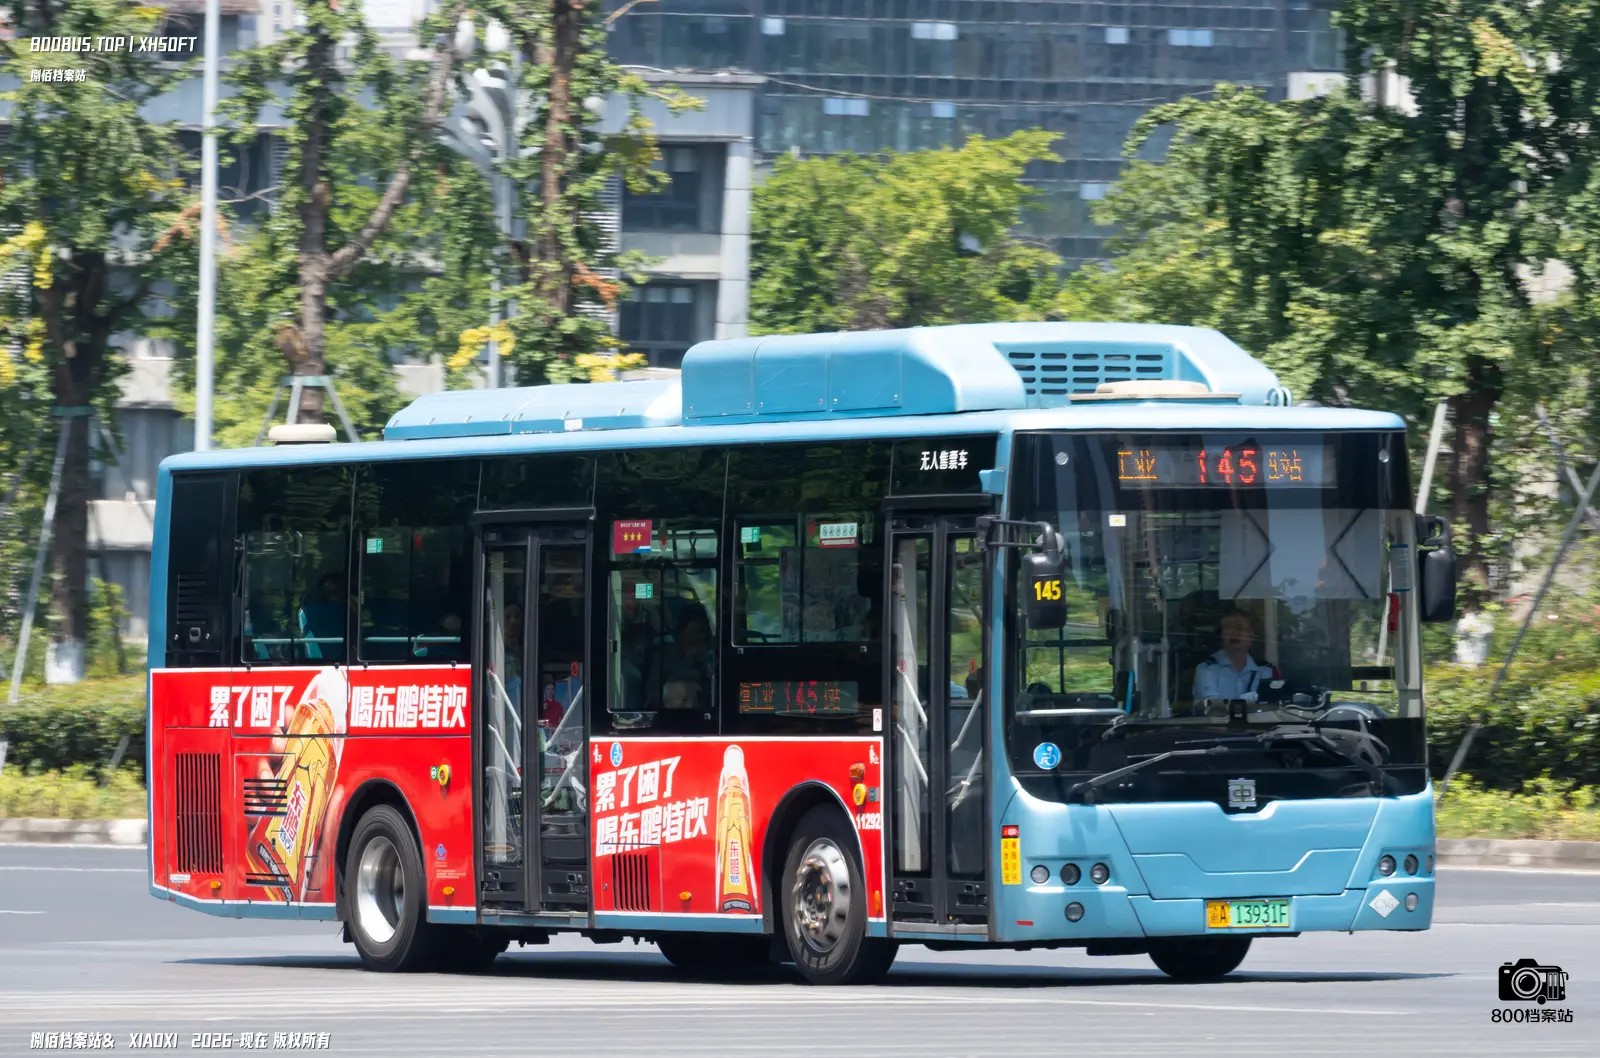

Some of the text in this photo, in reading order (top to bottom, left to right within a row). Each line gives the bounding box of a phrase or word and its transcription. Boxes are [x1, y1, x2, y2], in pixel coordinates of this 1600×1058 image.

[920, 449, 968, 470] 无人售票车
[1197, 449, 1257, 484] 145
[1034, 580, 1062, 600] 145
[209, 683, 467, 729] 累了困了 喝东鹏特饮
[784, 681, 818, 713] 145
[595, 755, 681, 813] 累了困了
[595, 796, 709, 858] 喝东鹏特饮
[1236, 904, 1287, 924] 13931F
